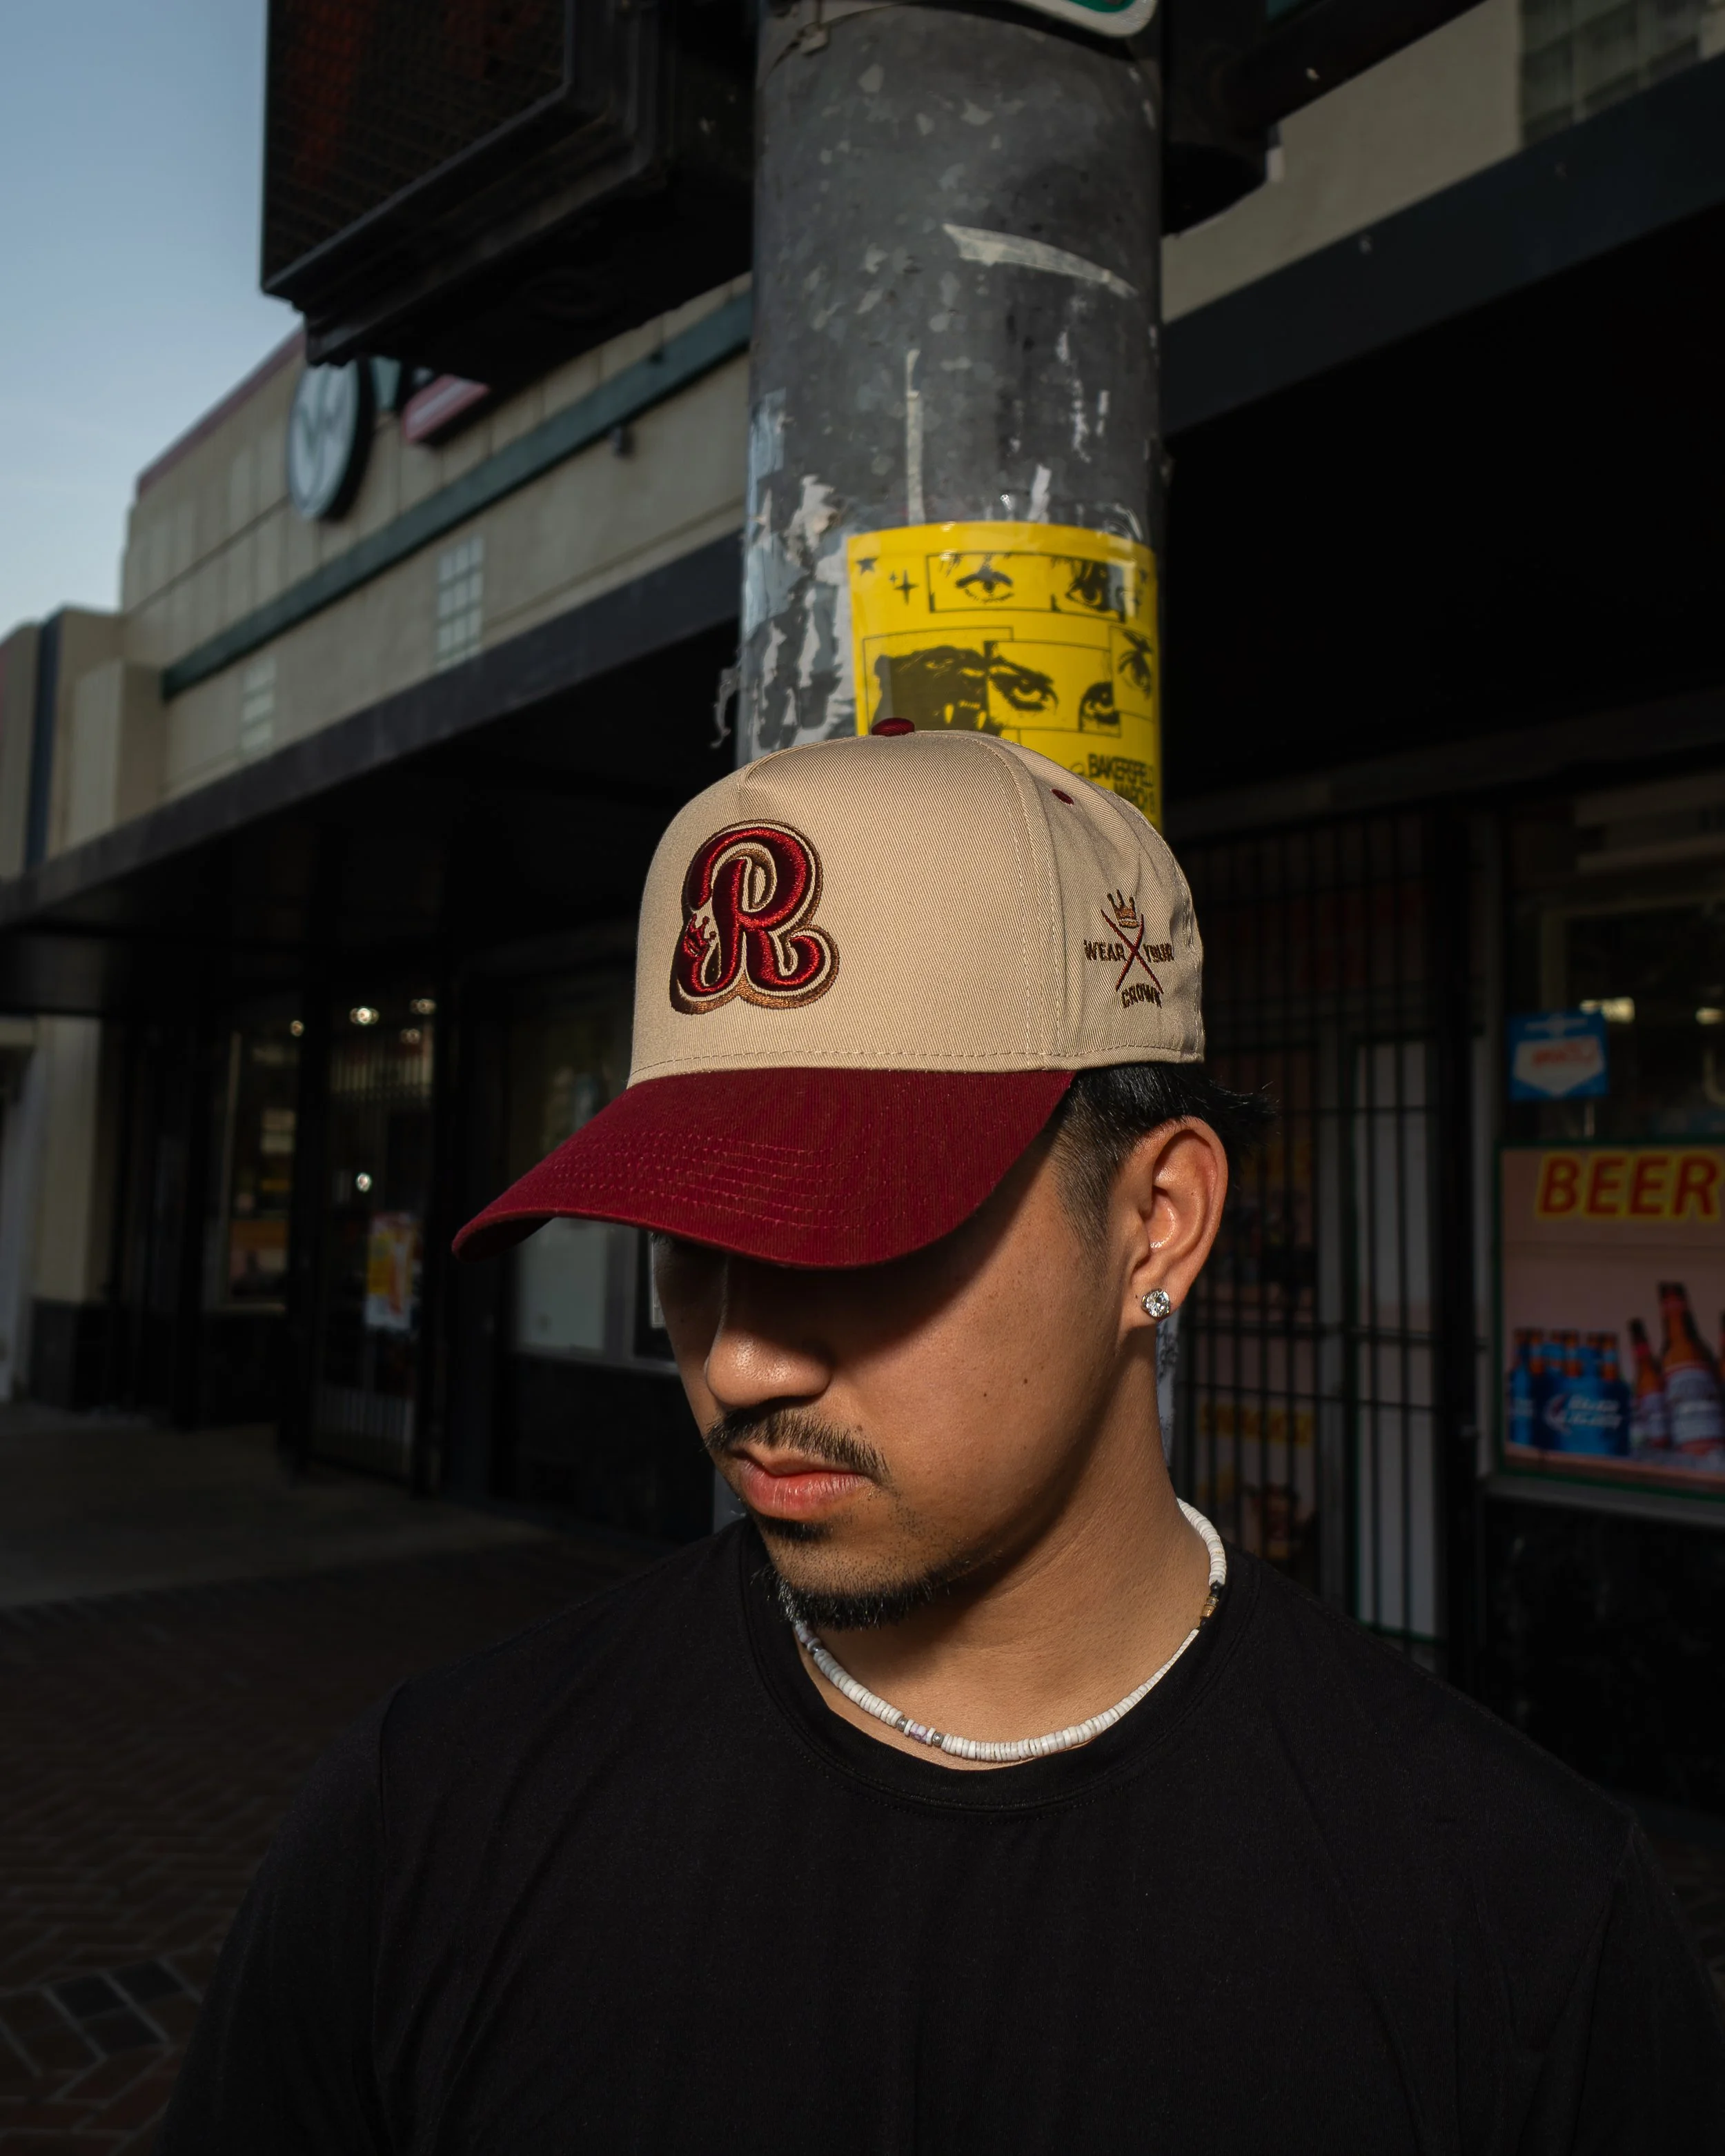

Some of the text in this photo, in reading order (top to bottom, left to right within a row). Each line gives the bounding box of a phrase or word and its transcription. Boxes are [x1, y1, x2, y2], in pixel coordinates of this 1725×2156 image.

[669, 819, 840, 1016] R
[1084, 940, 1174, 963] WEAR YOUR
[1536, 1151, 1722, 1221] BEER
